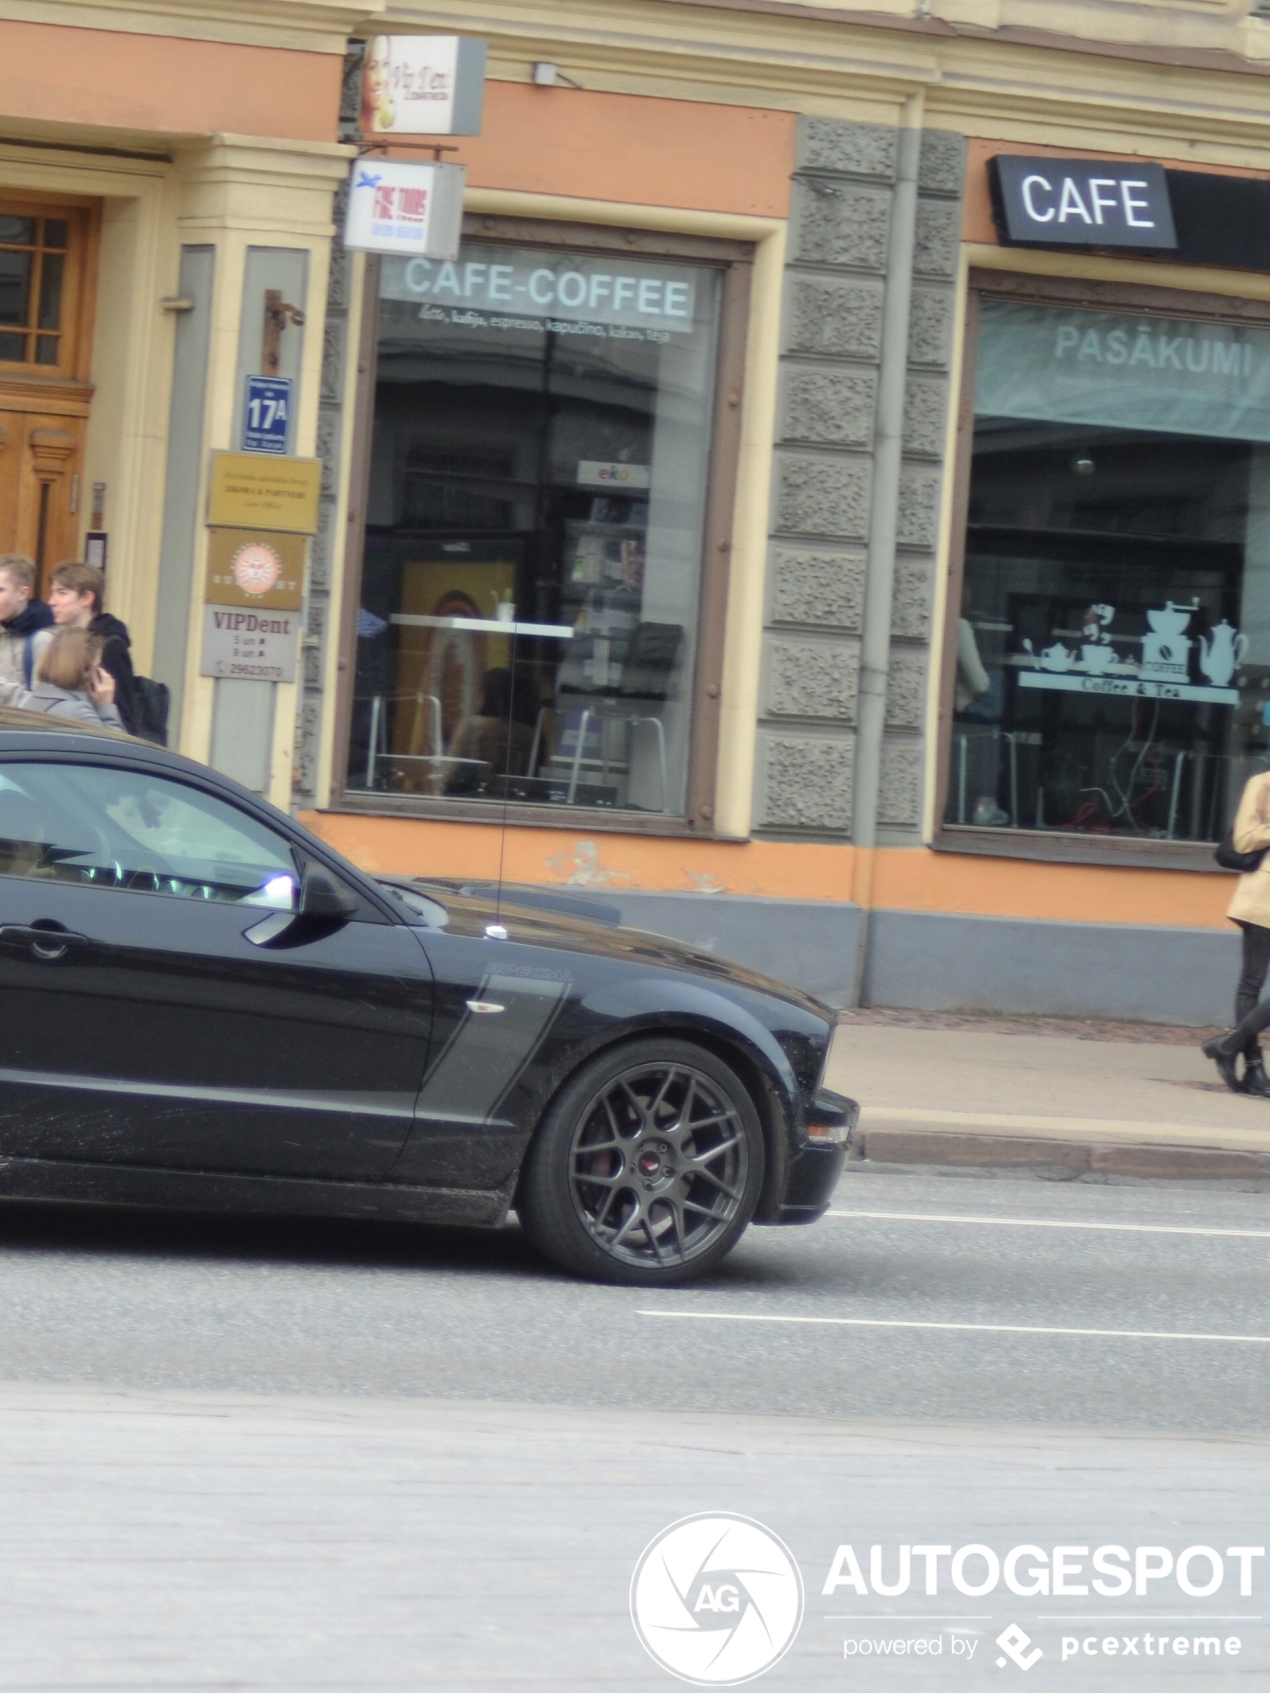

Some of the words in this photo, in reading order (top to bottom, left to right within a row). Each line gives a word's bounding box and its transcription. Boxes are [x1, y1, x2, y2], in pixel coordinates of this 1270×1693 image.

[1021, 175, 1155, 228] CAFE
[404, 257, 690, 318] CAFE-COFFEE
[1054, 325, 1252, 376] PASĀKUMI
[249, 398, 287, 429] 17A
[213, 612, 290, 634] VIPDent
[1081, 678, 1129, 694] Coffee
[1136, 683, 1148, 695] &
[1156, 684, 1180, 697] Tea
